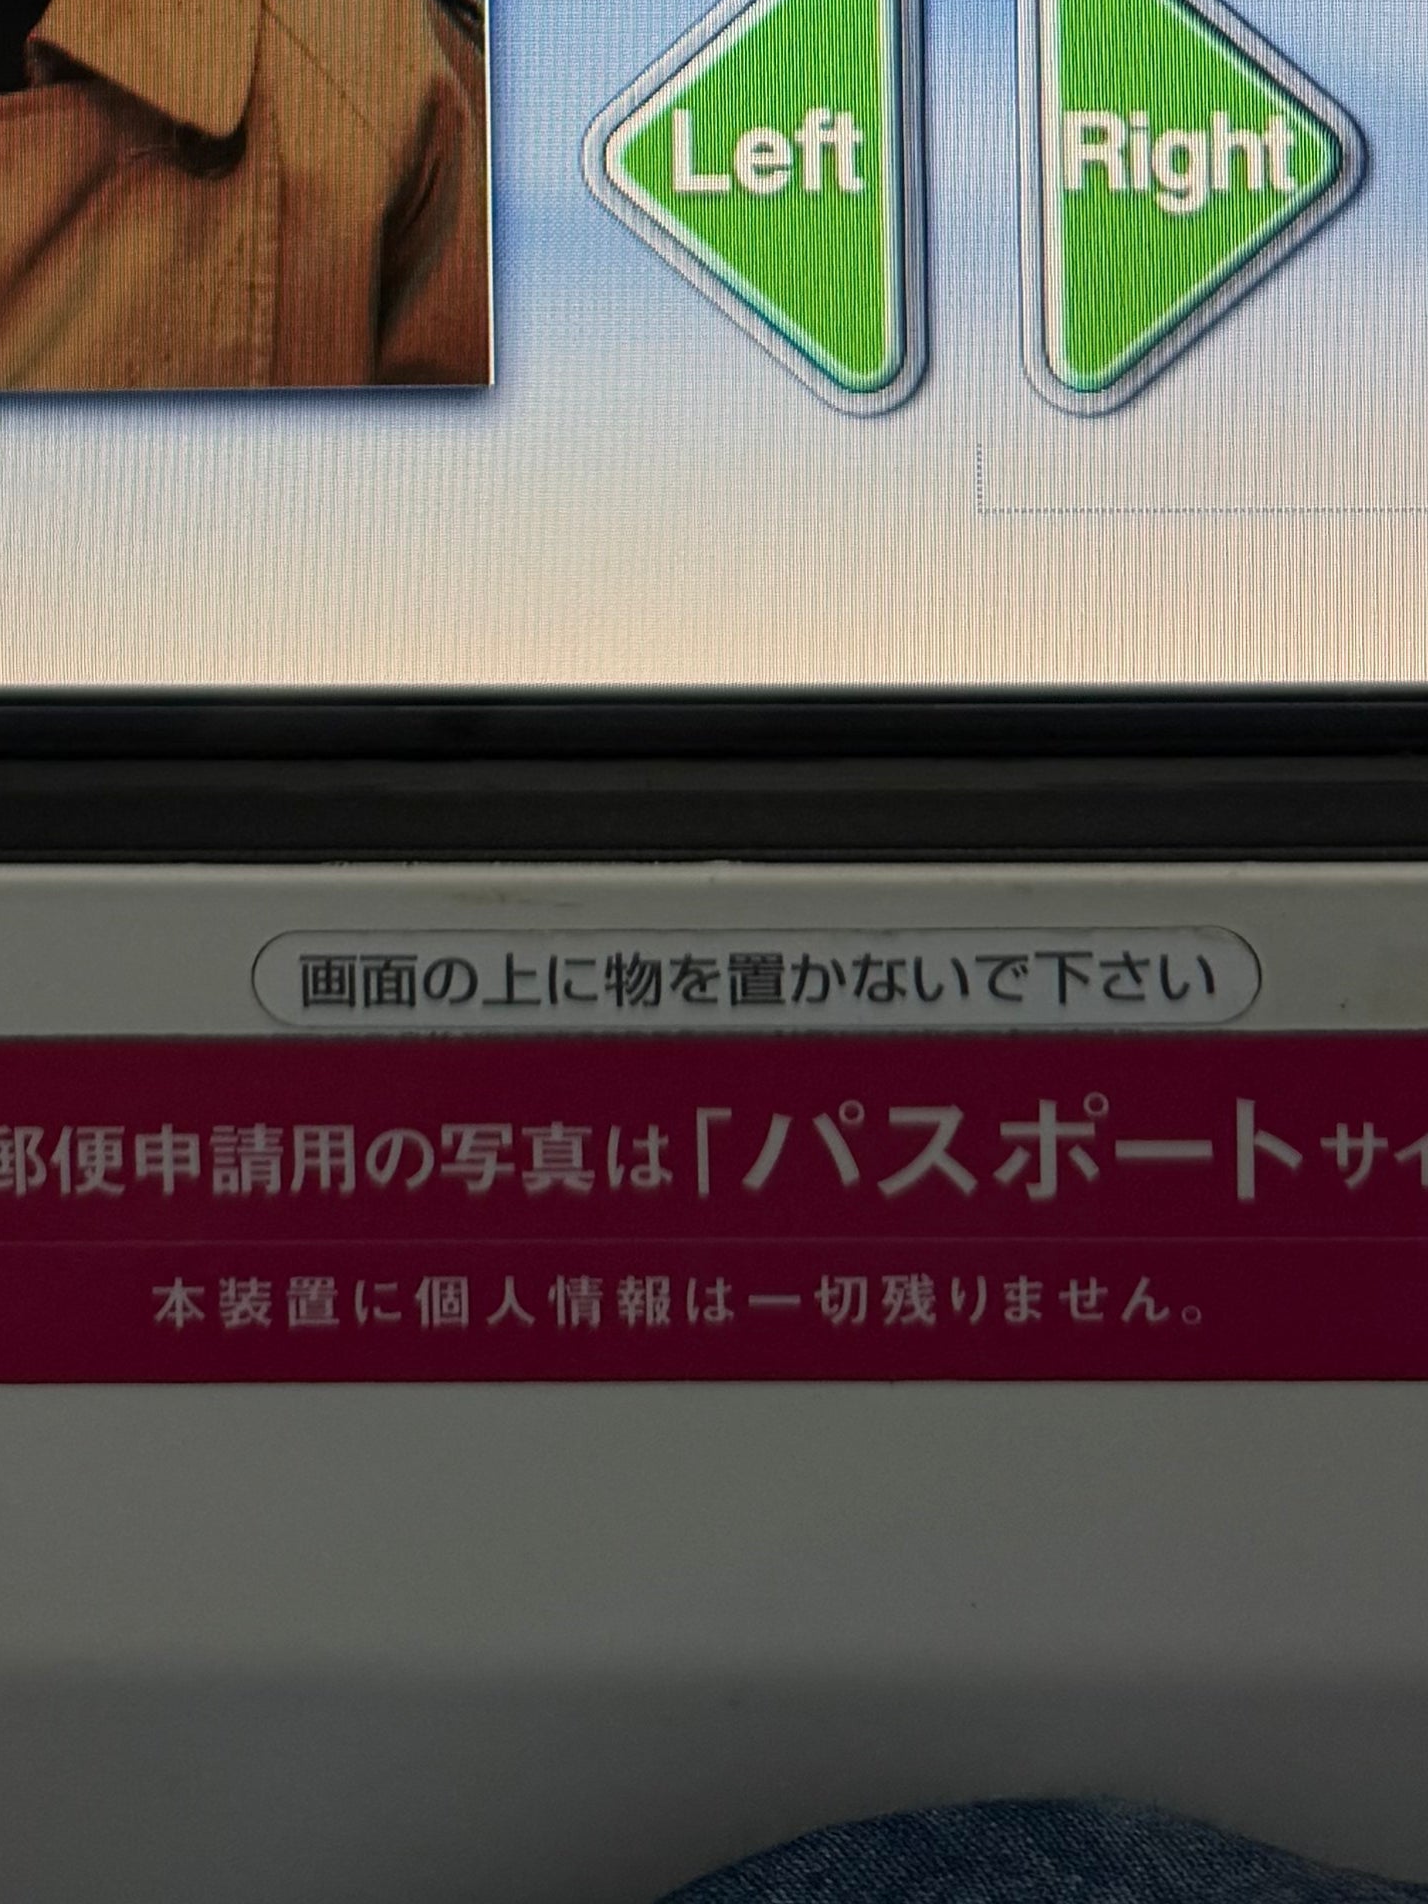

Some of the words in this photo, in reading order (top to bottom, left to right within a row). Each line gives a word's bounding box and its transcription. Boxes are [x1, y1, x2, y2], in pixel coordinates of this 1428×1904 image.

[668, 107, 866, 195] Left
[1061, 109, 1298, 217] Right
[298, 950, 1217, 1011] 画面の上に物を置かないで下さい
[151, 1272, 1204, 1332] 本装置に個人情報は一切残りません。
